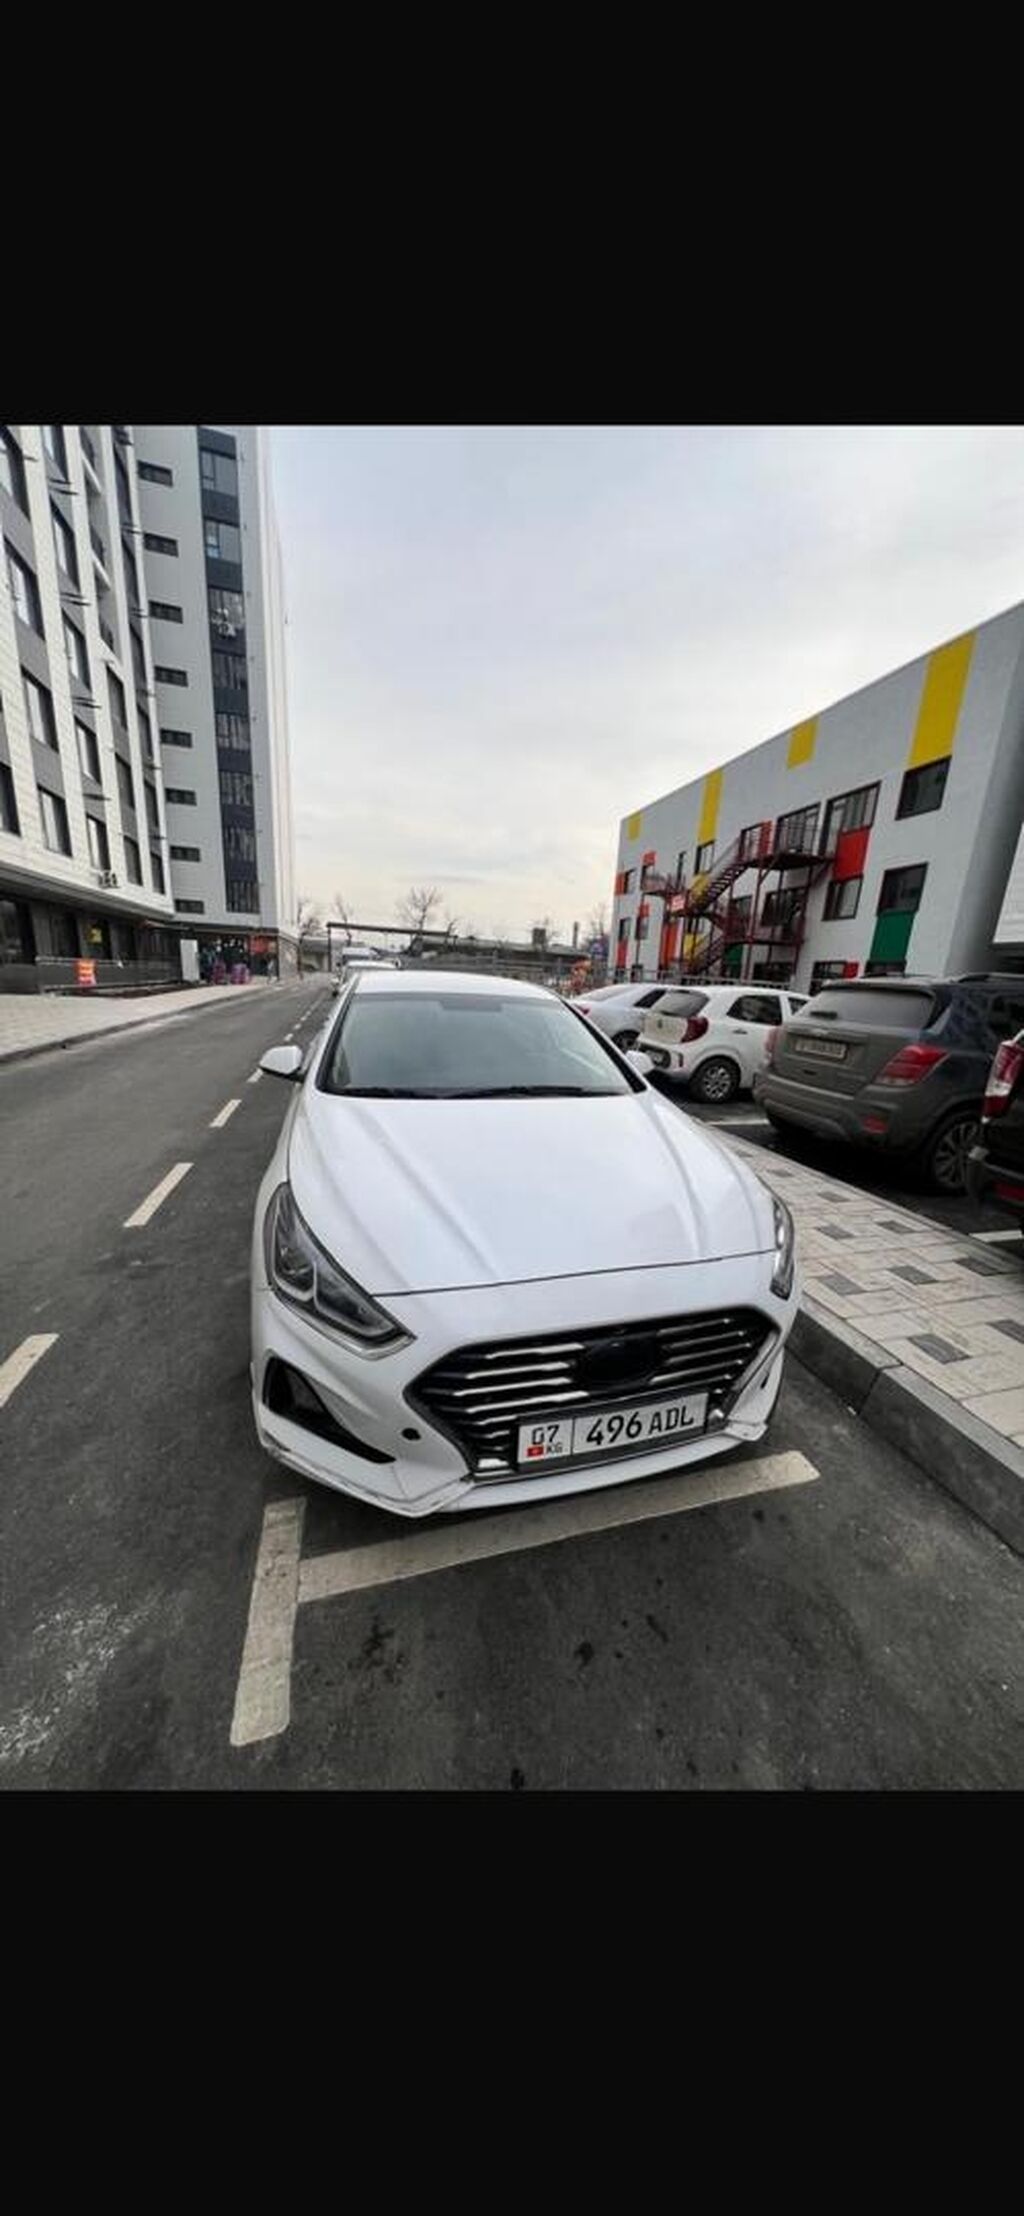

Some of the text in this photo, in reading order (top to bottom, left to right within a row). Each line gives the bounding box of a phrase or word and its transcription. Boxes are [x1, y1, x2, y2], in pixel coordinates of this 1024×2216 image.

[532, 1406, 694, 1446] 07 496 ADL
[546, 1443, 563, 1454] KG
